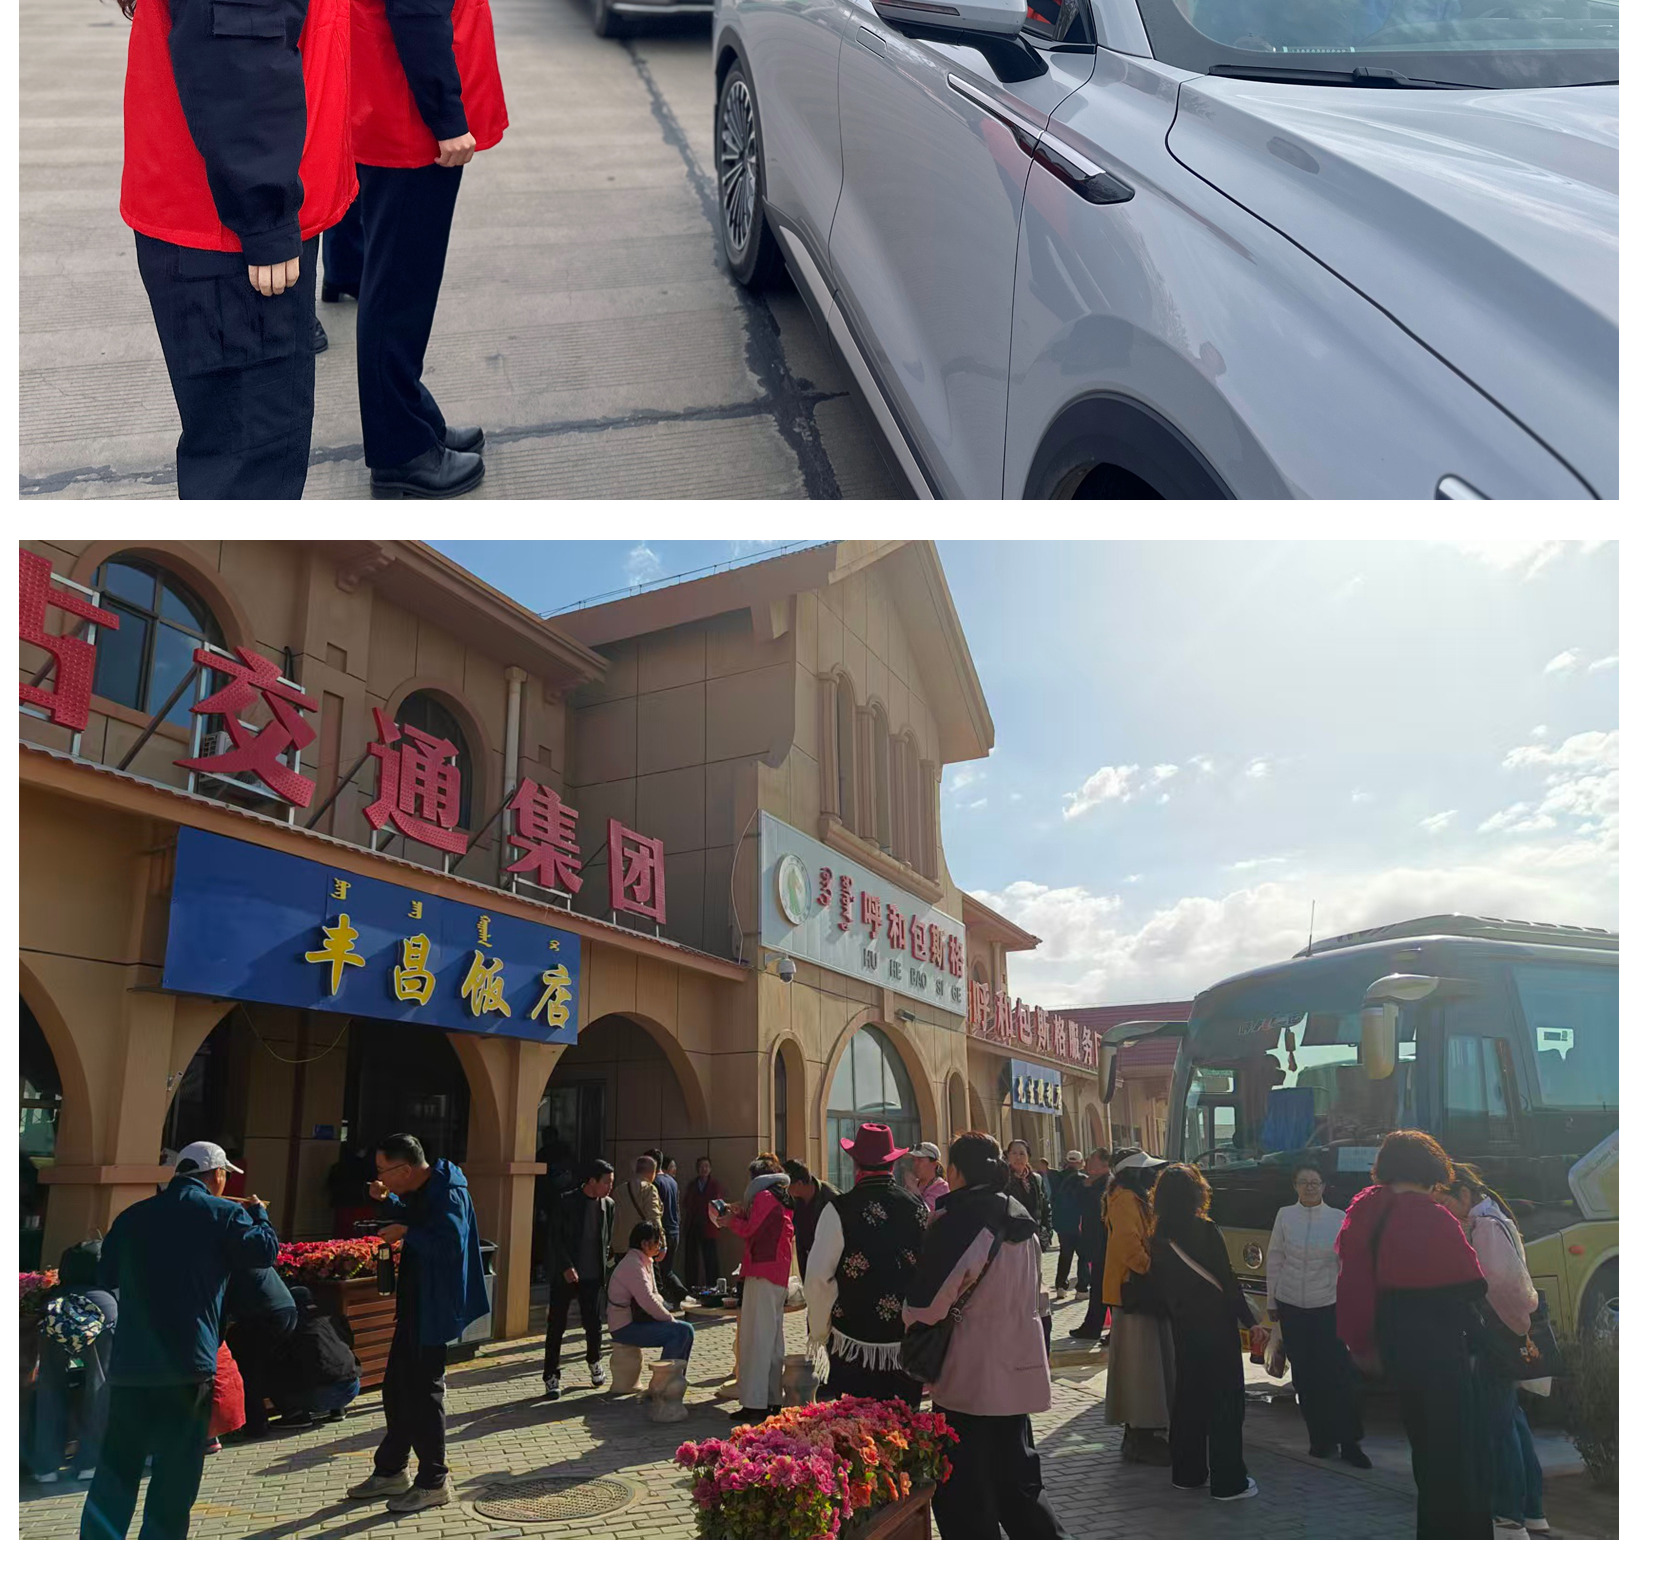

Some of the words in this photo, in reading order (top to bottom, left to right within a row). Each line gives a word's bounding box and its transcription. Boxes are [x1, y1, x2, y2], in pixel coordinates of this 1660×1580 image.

[305, 913, 572, 1029] 丰昌饭店
[889, 959, 902, 980] HE
[910, 968, 927, 990] BAO
